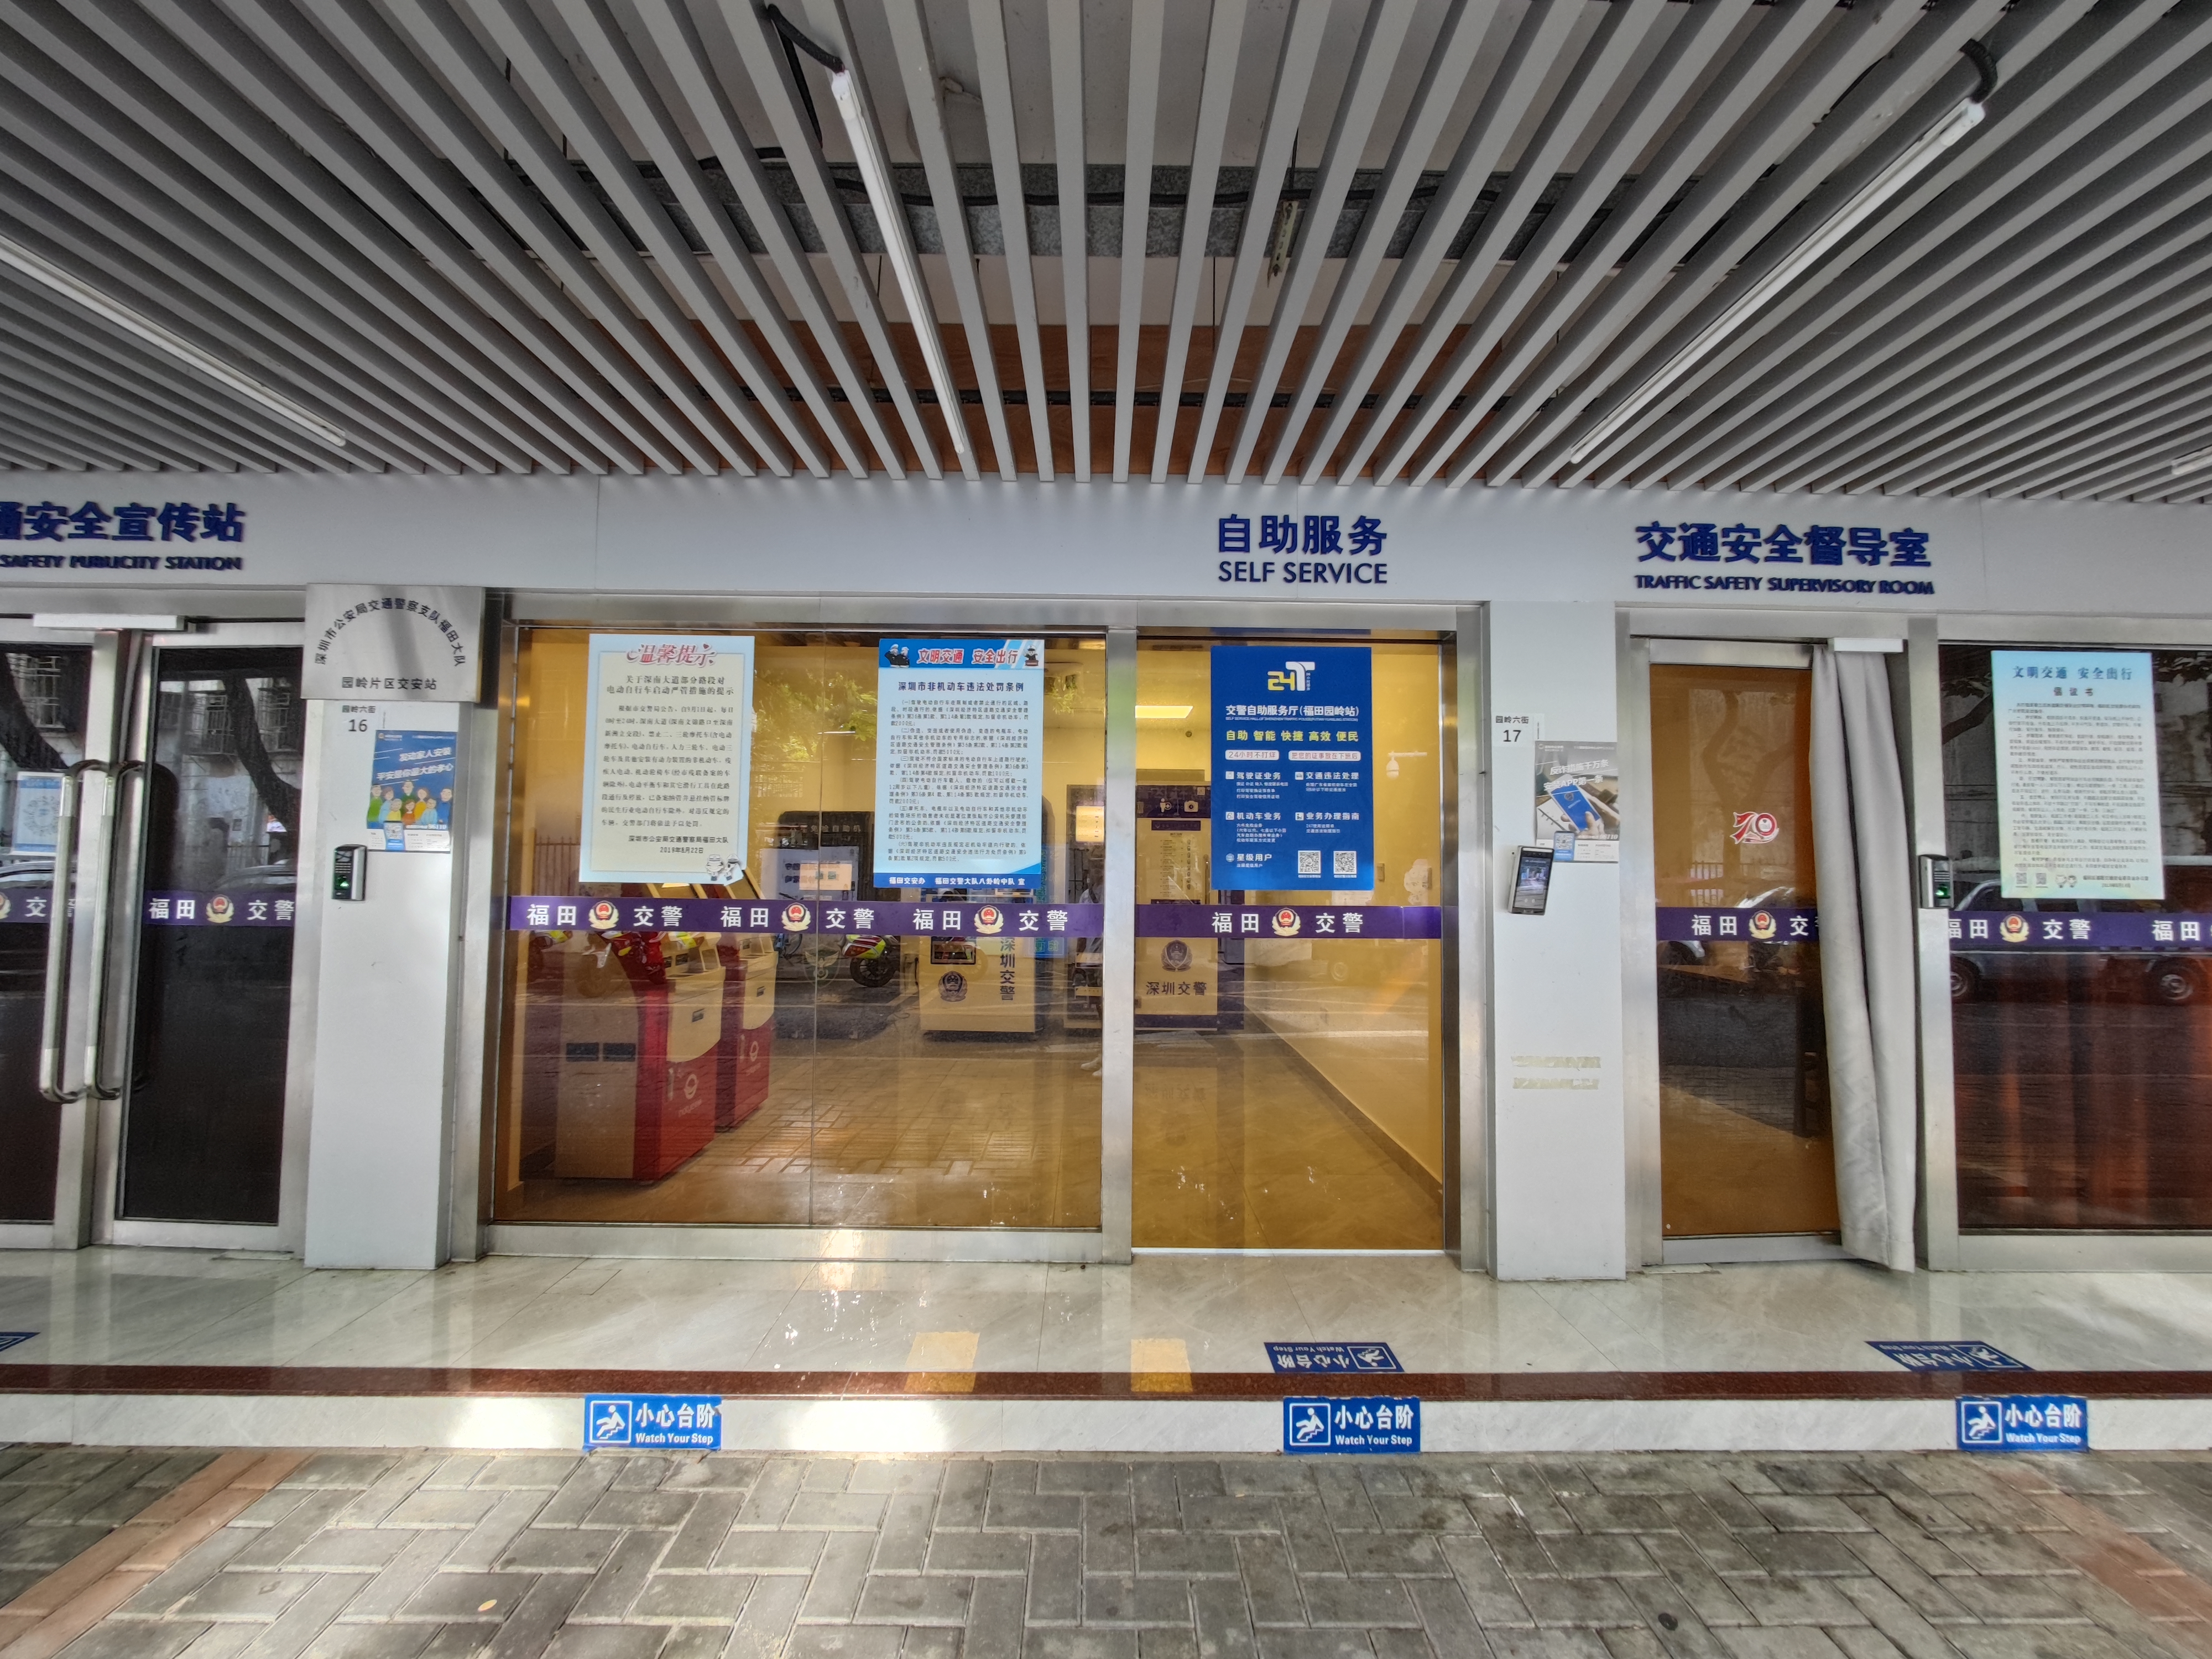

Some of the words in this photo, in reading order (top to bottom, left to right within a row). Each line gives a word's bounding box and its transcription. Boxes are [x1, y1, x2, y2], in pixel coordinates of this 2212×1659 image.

[1218, 514, 1387, 556] 自助服务
[1635, 521, 1931, 567] 交通安全督导室
[70, 555, 160, 570] PUBLICITY
[165, 556, 243, 571] STATION
[1219, 561, 1275, 582] SELF
[1283, 562, 1387, 584] SERVICE
[1635, 575, 1702, 589] TRAFFIC
[1705, 576, 1762, 591] SAFETY
[1769, 578, 1875, 593] SUPERVISORY
[1880, 581, 1935, 595] ROOM
[315, 598, 466, 667] 深圳市公安局交通警察支队福田大队
[627, 644, 716, 666] 温馨提示
[917, 648, 964, 664] 文明交通
[971, 648, 1019, 664] 安全出行
[2012, 666, 2067, 679] 文明交通
[2078, 667, 2132, 680] 安全出行
[342, 677, 437, 690] 园岭片区交安站
[898, 682, 1024, 692] 深圳市非机动车违法处罚条例
[342, 705, 376, 713] 园岭六街
[348, 719, 368, 732] 16
[1495, 716, 1529, 724] 园岭六街
[1226, 731, 1248, 741] 自助
[1253, 731, 1276, 741] 智能
[1281, 731, 1304, 741] 快捷
[1308, 731, 1331, 742] 高效
[1336, 731, 1359, 742] 便民
[1503, 729, 1521, 742] 17
[1237, 771, 1281, 780] 驾驶证业务
[1550, 759, 1609, 775] 反诈措施千万条
[1237, 853, 1272, 862] 星级用户
[149, 898, 195, 919] 福田
[248, 900, 295, 921] 交警
[526, 904, 577, 926] 福田
[633, 905, 683, 927] 交警
[721, 905, 769, 928] 福田
[826, 907, 875, 929] 交警
[912, 909, 961, 930] 福田
[1019, 910, 1068, 931] 交警
[1212, 912, 1260, 933] 福田
[1315, 913, 1364, 933] 交警
[1691, 914, 1738, 936] 福田
[2043, 919, 2091, 940] 交警
[2152, 920, 2200, 941] 福田
[1000, 937, 1015, 1001] 深圳交警
[1146, 981, 1207, 995] 深圳交警
[1277, 1354, 1350, 1369] 小心台阶
[635, 1403, 715, 1428] 小心台阶
[1334, 1404, 1414, 1430] 小心台阶
[2005, 1402, 2082, 1428] 小心台阶
[636, 1433, 666, 1443] Watch
[668, 1433, 690, 1443] Your
[691, 1433, 714, 1445] Step
[1335, 1434, 1365, 1445] Watch
[1367, 1434, 1389, 1445] Your
[1391, 1434, 1413, 1447] Step
[2006, 1433, 2035, 1443] Watch
[2037, 1433, 2059, 1443] Your
[2060, 1433, 2081, 1445] Step
